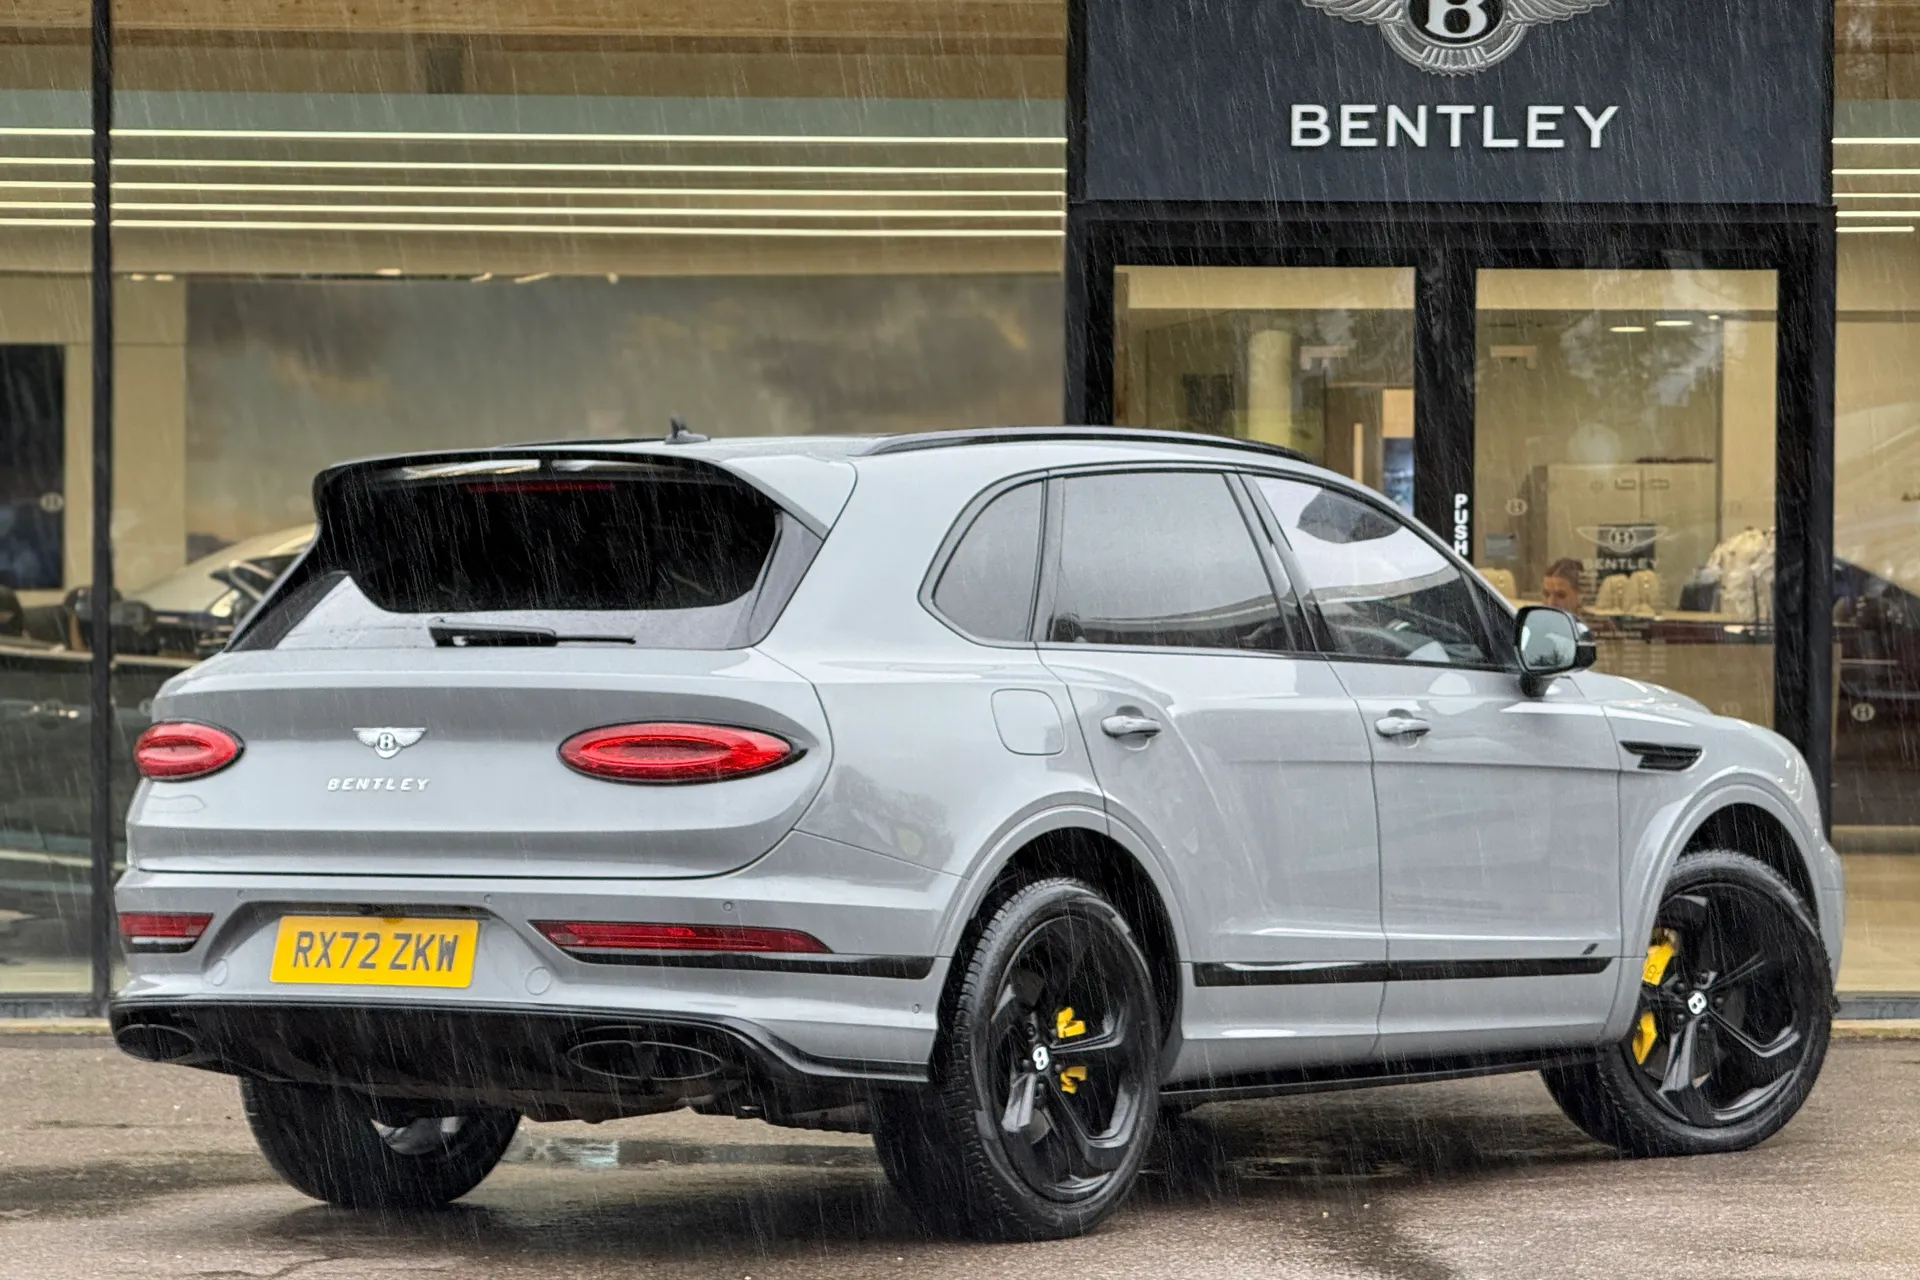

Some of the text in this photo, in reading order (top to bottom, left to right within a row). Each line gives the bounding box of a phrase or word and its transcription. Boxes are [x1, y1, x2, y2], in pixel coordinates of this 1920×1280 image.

[1290, 104, 1619, 148] BENTLEY
[1454, 493, 1469, 556] PUSH
[327, 777, 430, 792] BENTLEY
[292, 931, 459, 972] RX72 ZKW
